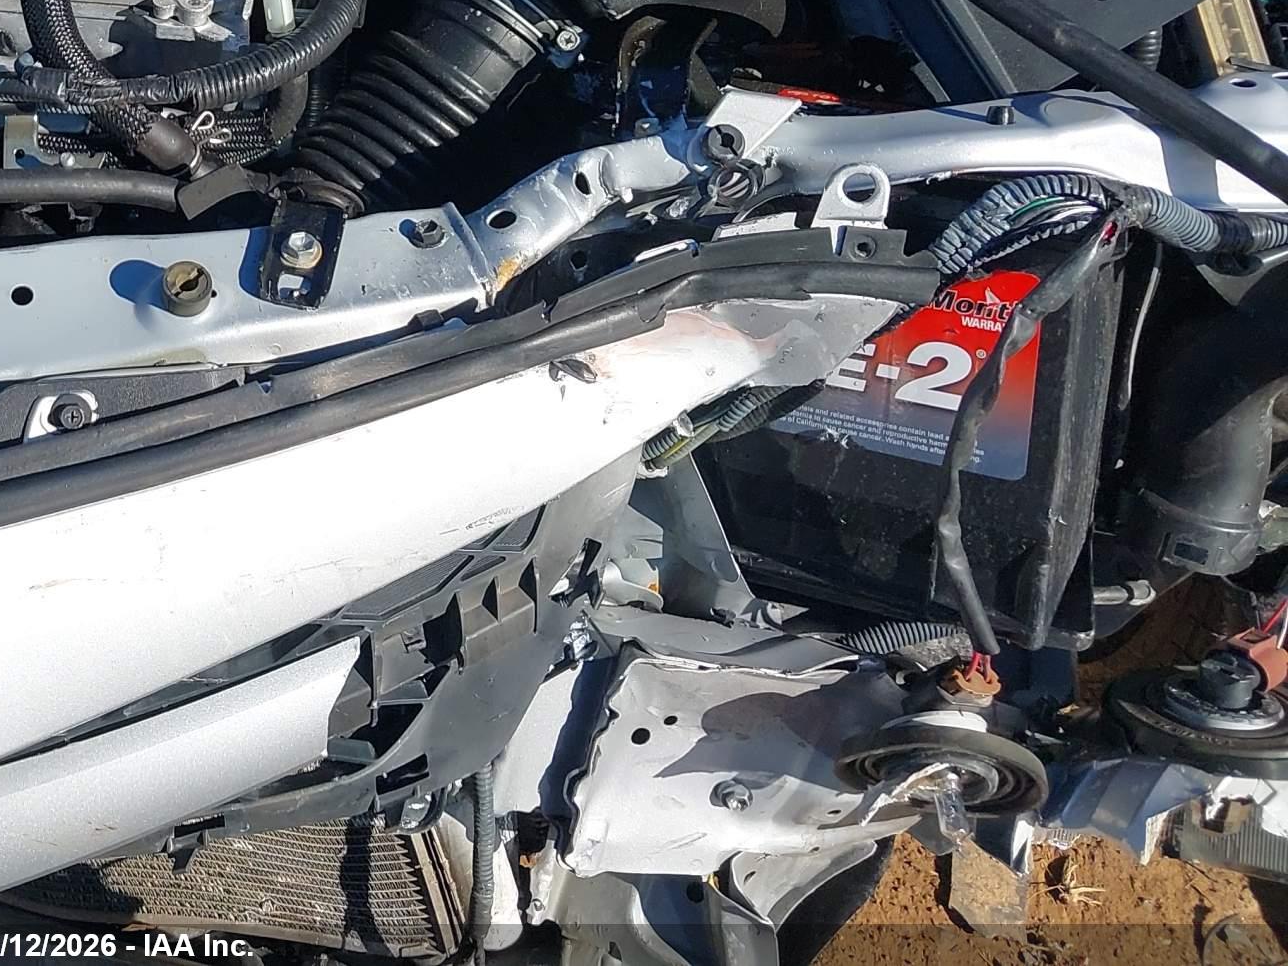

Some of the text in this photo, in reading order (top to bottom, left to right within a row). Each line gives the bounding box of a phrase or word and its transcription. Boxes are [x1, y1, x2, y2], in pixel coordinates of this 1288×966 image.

[932, 290, 1017, 322] Mont
[961, 316, 1006, 333] WARRA
[815, 408, 829, 416] and
[830, 411, 855, 421] related
[898, 425, 926, 437] contain
[927, 430, 944, 440] lead
[822, 416, 842, 425] cause
[843, 421, 867, 431] cancer
[867, 426, 881, 435] and
[882, 429, 928, 444] reproductive
[837, 427, 857, 436] cause
[885, 436, 905, 447] Wash
